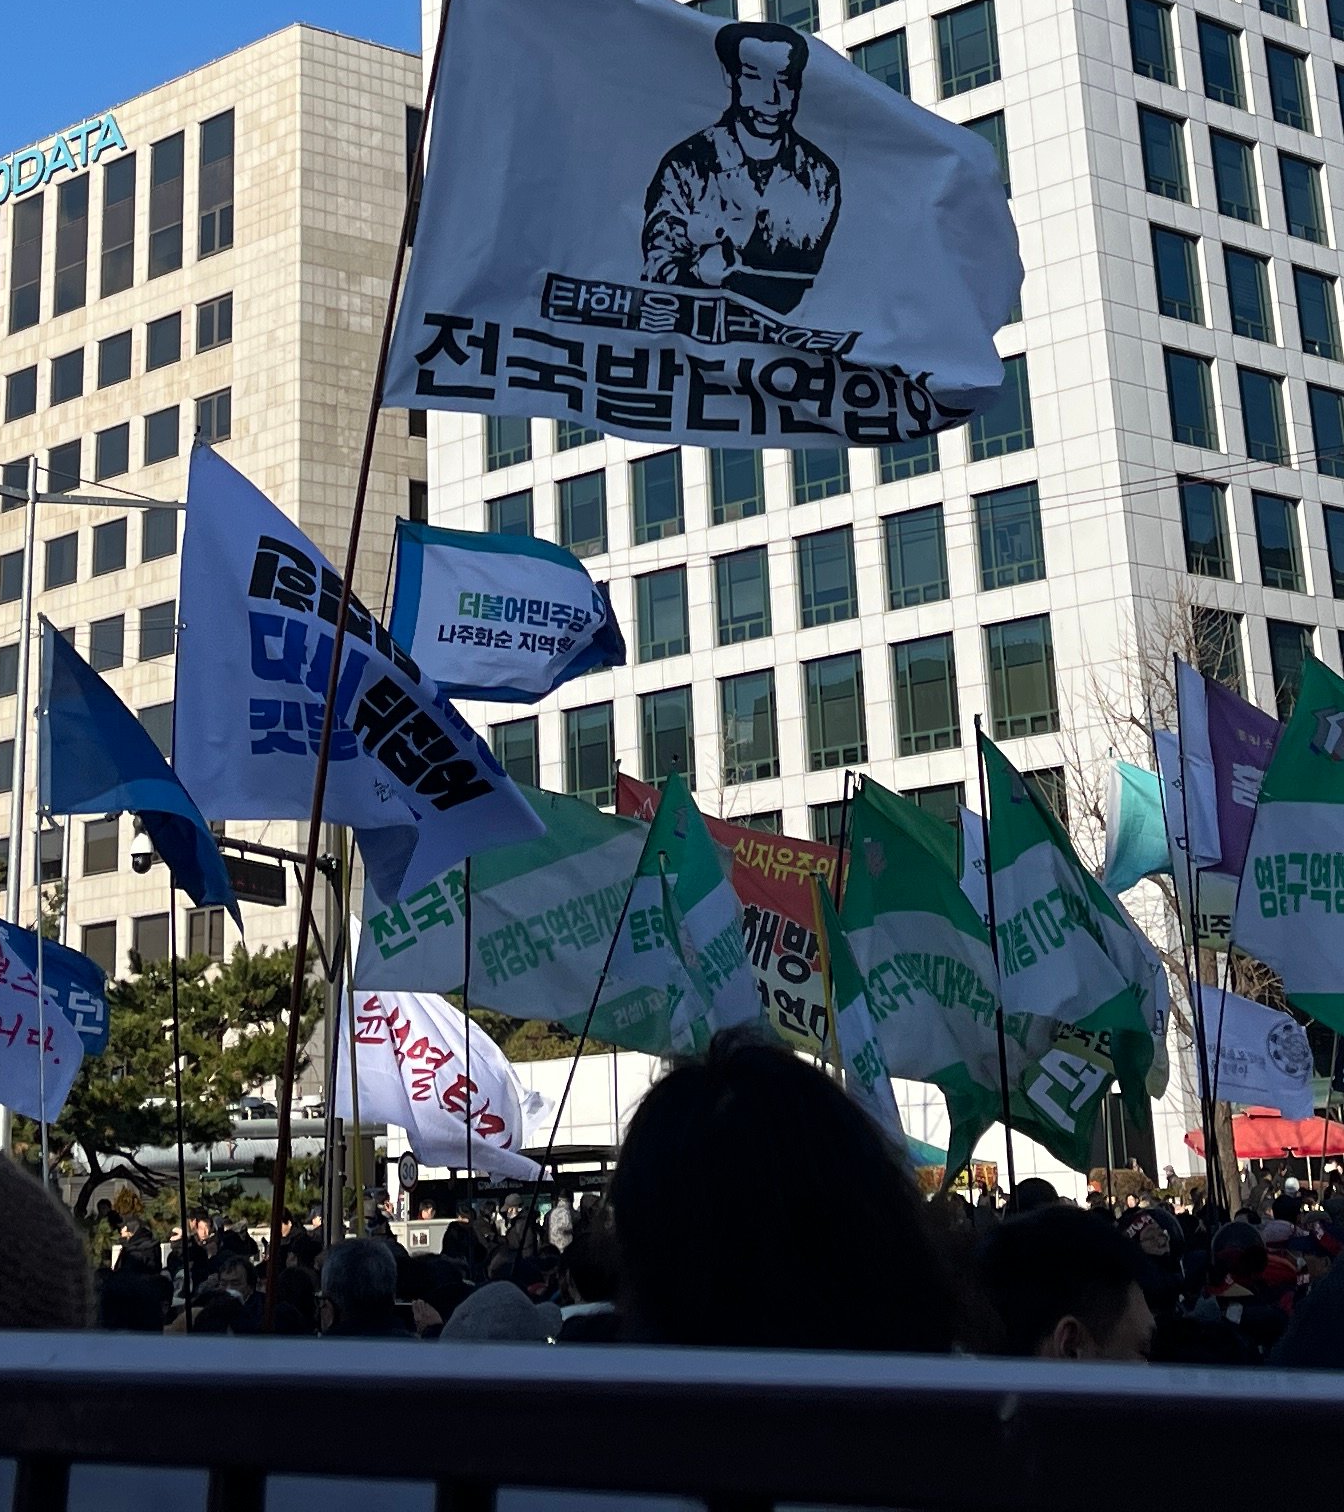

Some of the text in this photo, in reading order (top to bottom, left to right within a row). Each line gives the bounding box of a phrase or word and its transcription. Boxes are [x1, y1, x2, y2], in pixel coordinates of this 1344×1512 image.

[552, 279, 680, 331] 탄핵을
[459, 590, 593, 634] 더불어민주당
[438, 624, 513, 650] 나주화순
[402, 1163, 414, 1179] 30
